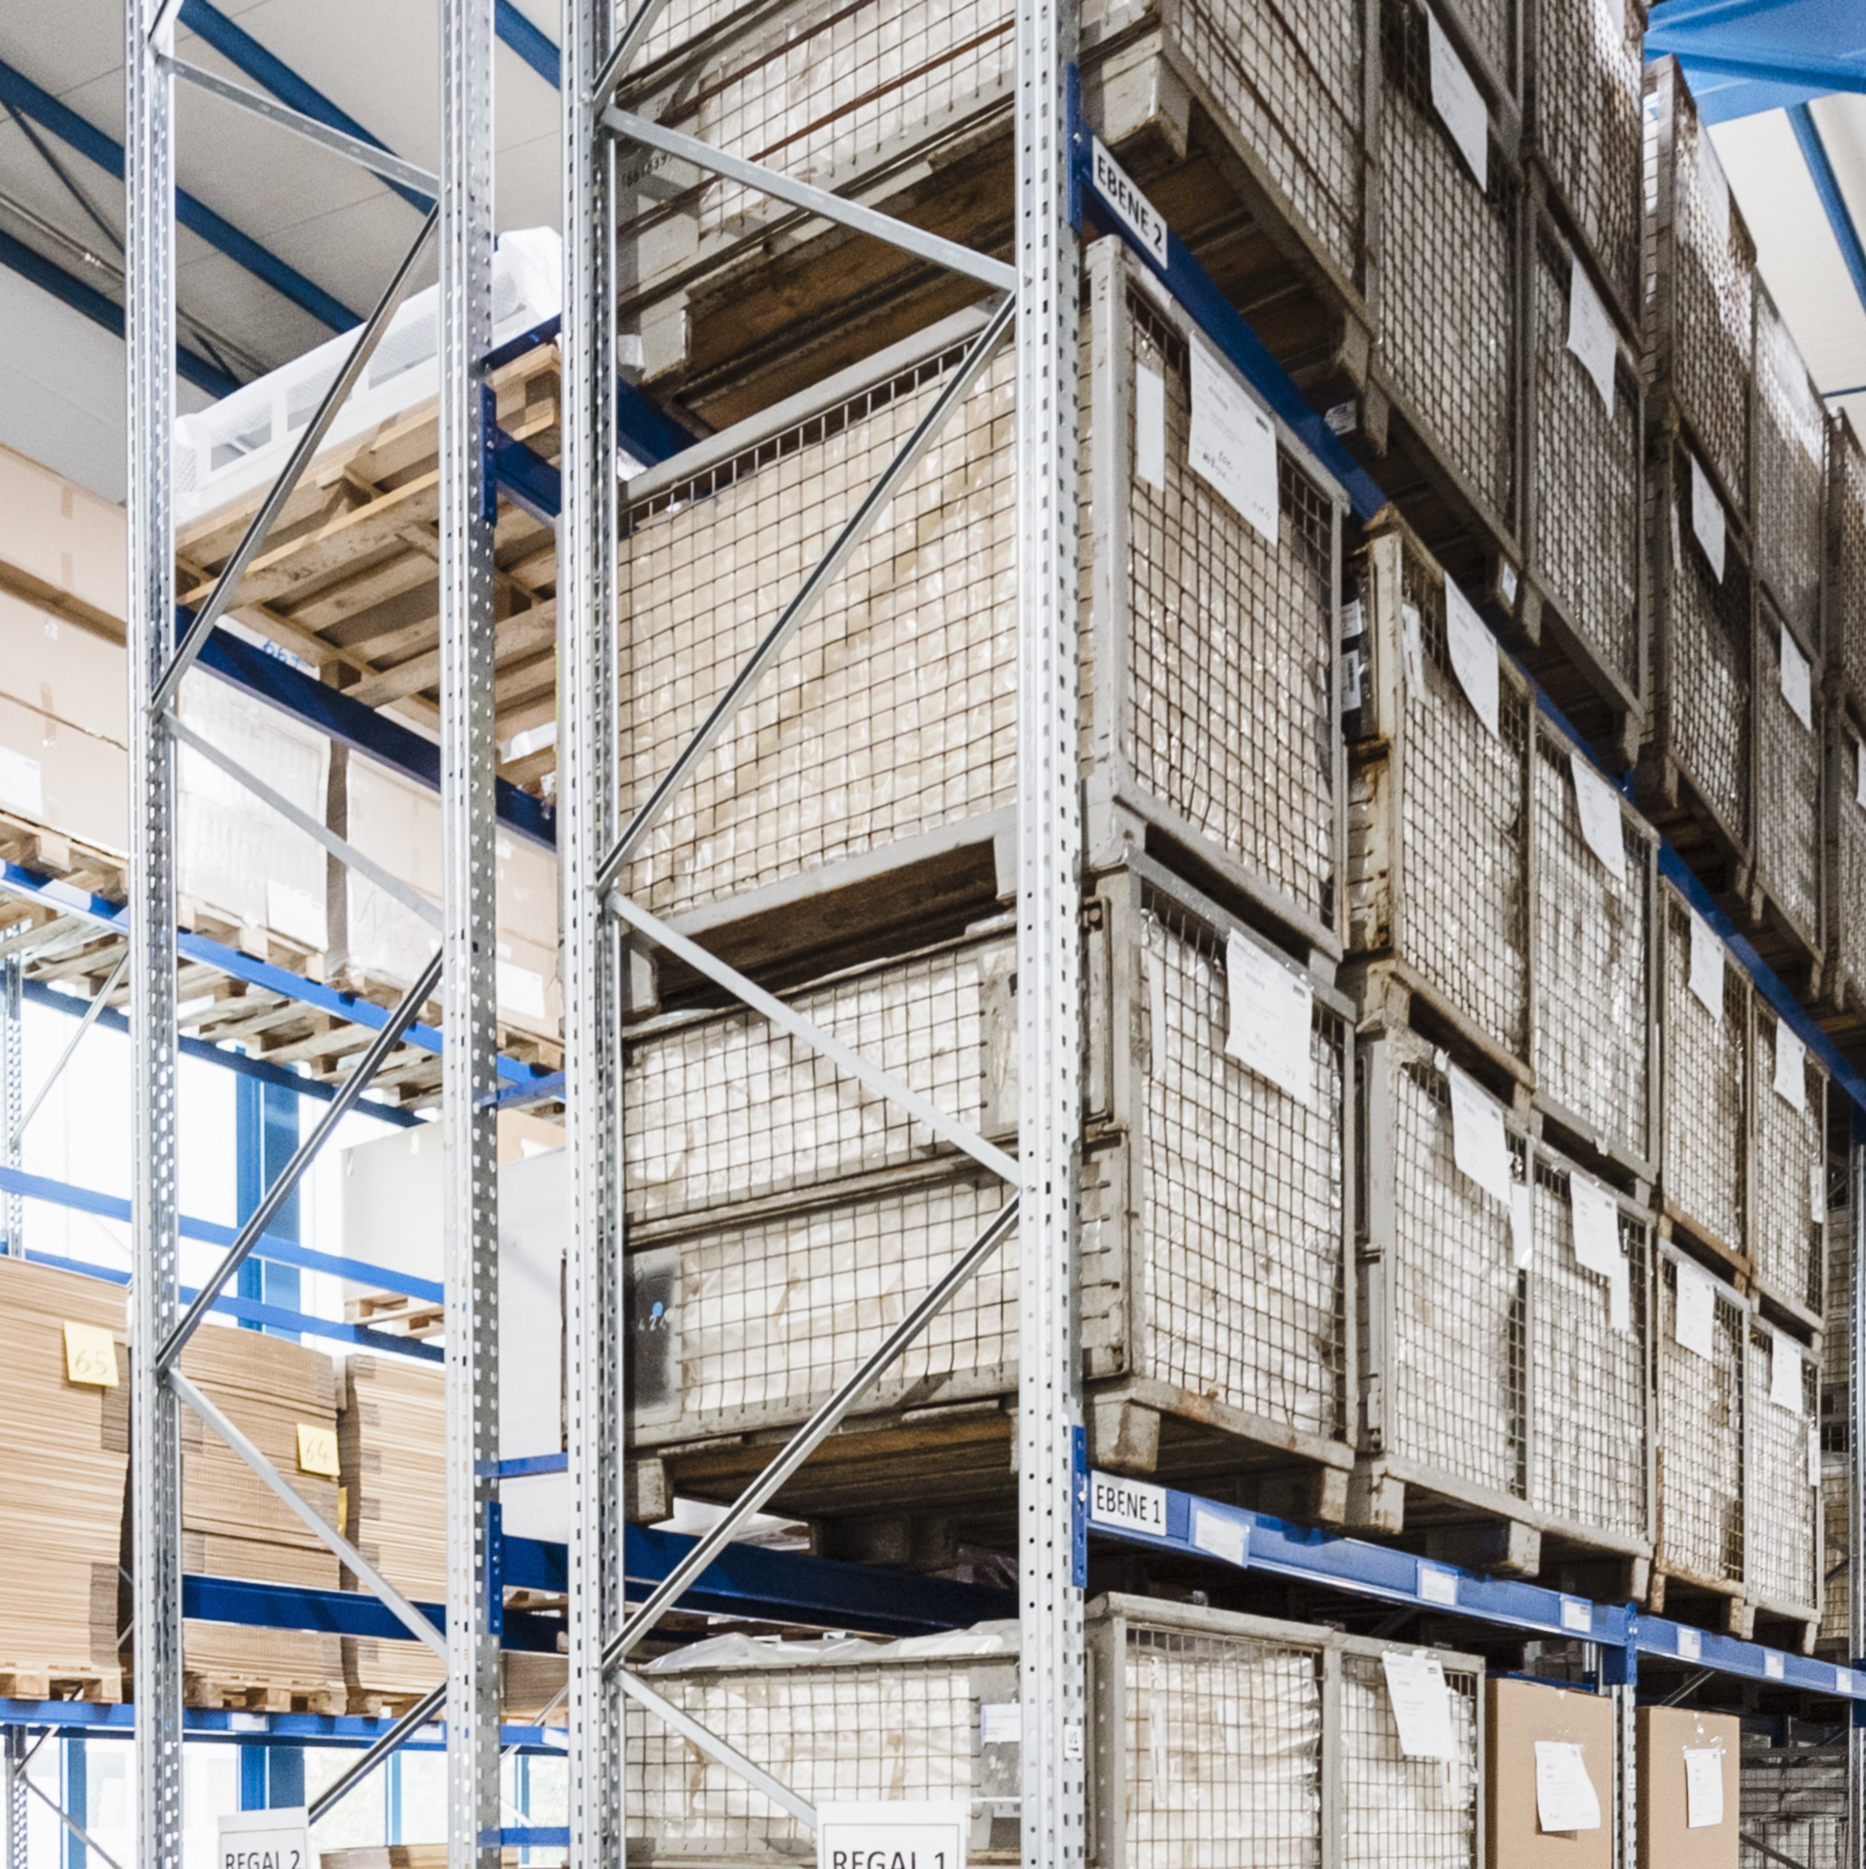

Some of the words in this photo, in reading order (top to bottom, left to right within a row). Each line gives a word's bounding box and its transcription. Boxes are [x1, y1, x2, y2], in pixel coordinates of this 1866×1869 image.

[1097, 153, 1149, 238] EBENE
[1153, 222, 1163, 254] 2
[74, 1348, 108, 1377] 65
[305, 1438, 333, 1467] 64
[1096, 1484, 1148, 1522] EBENE
[1152, 1499, 1162, 1525] 1
